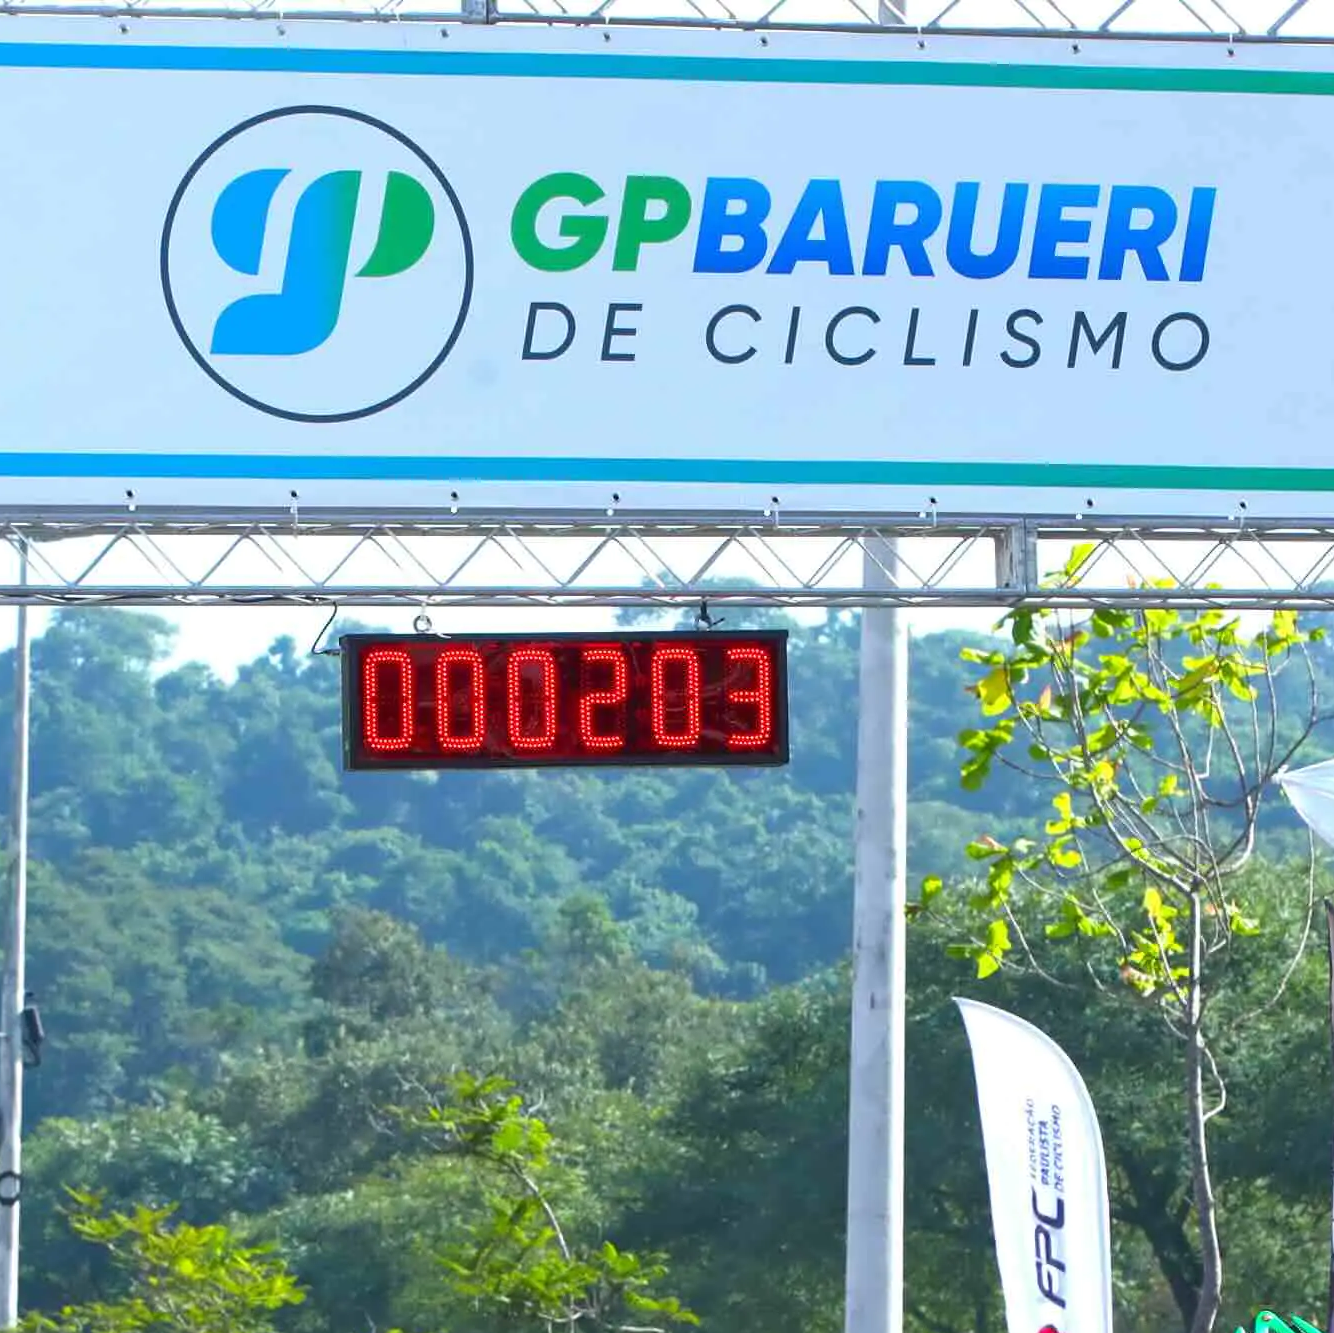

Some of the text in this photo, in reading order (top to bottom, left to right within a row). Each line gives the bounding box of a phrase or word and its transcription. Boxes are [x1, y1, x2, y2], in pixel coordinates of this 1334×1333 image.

[509, 171, 1217, 283] GPBARUERI
[522, 301, 1212, 372] DE CICLISMO
[1031, 1184, 1067, 1309] FPC
